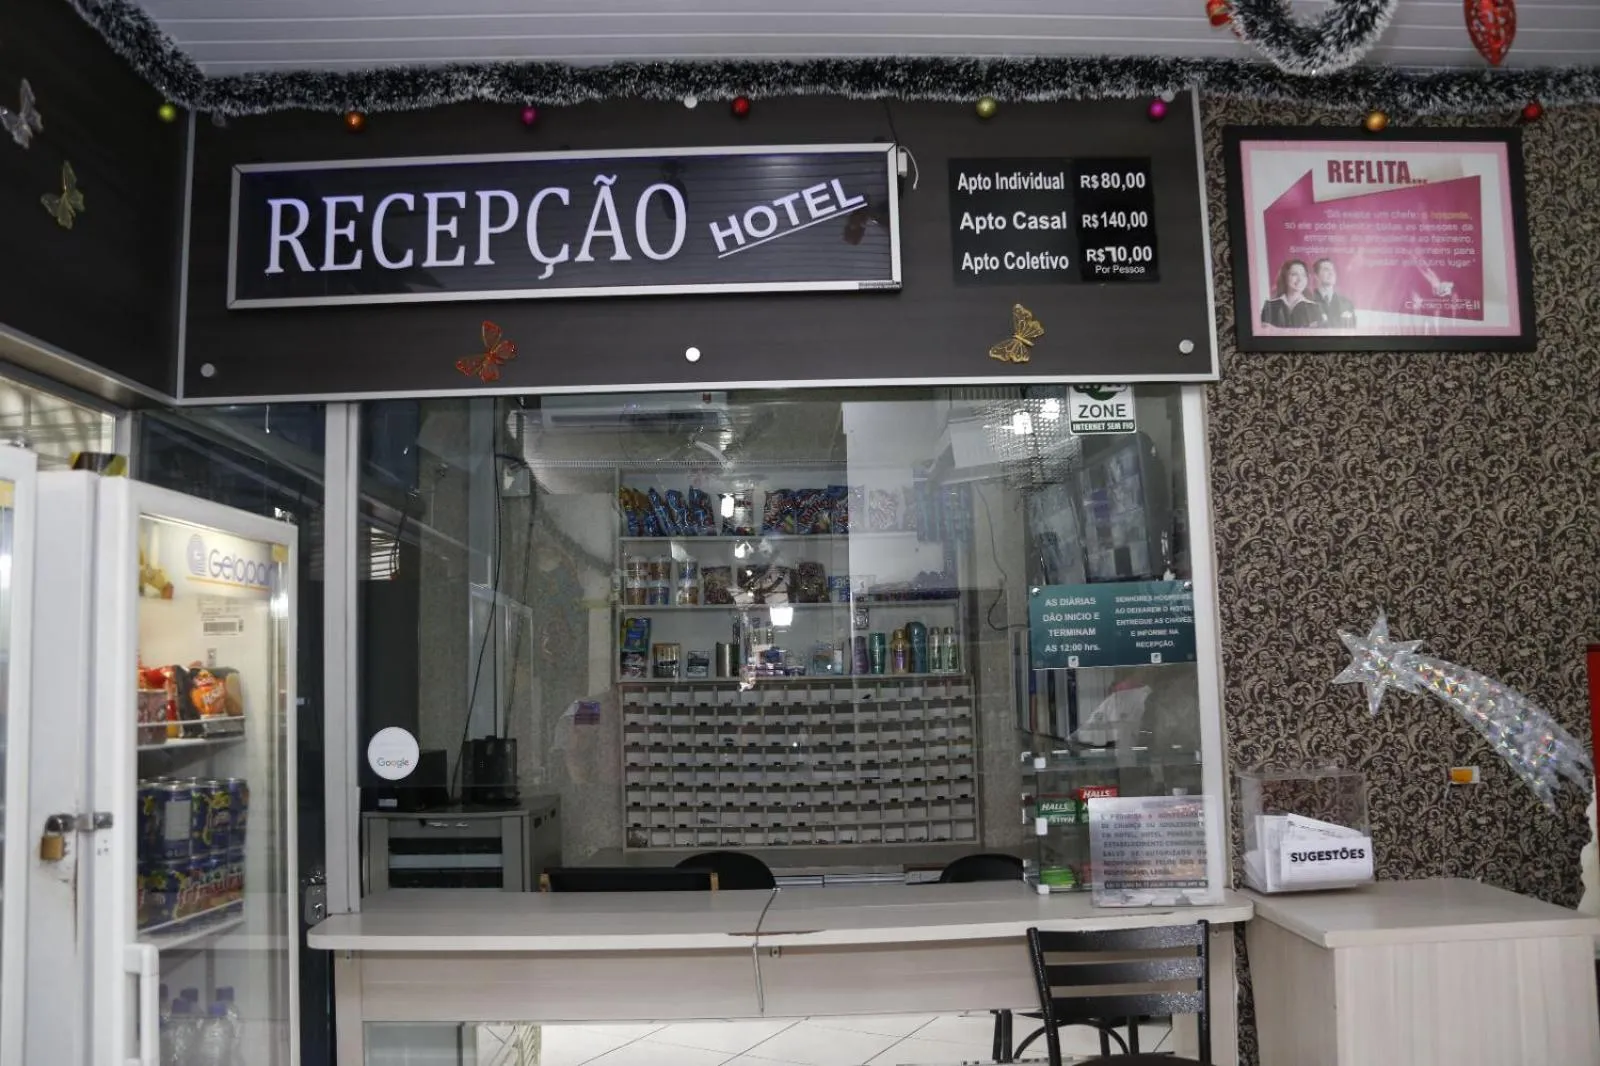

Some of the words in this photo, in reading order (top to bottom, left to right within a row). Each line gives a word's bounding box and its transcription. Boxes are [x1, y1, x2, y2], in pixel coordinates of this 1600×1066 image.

[1327, 159, 1428, 184] REFLITA...
[957, 172, 991, 194] Apto
[995, 172, 1065, 190] Individual
[709, 178, 865, 253] HOTEL
[959, 211, 1007, 234] Apto
[1012, 211, 1067, 230] Casal
[265, 174, 686, 279] RECEPÇÃO
[961, 252, 1000, 275] Apto
[1004, 251, 1069, 270] Coletivo
[1095, 265, 1111, 274] Por
[1112, 264, 1146, 274] Pessoa
[1078, 403, 1127, 418] ZONE
[1073, 422, 1105, 431] INTERNET
[1107, 421, 1121, 430] SEM
[1048, 627, 1097, 637] TERMINAM
[1060, 643, 1083, 652] 12:00
[376, 756, 409, 769] Google
[1083, 788, 1111, 799] HALLS
[1041, 802, 1068, 812] HALLS
[1291, 847, 1365, 862] SUGESTÕES
